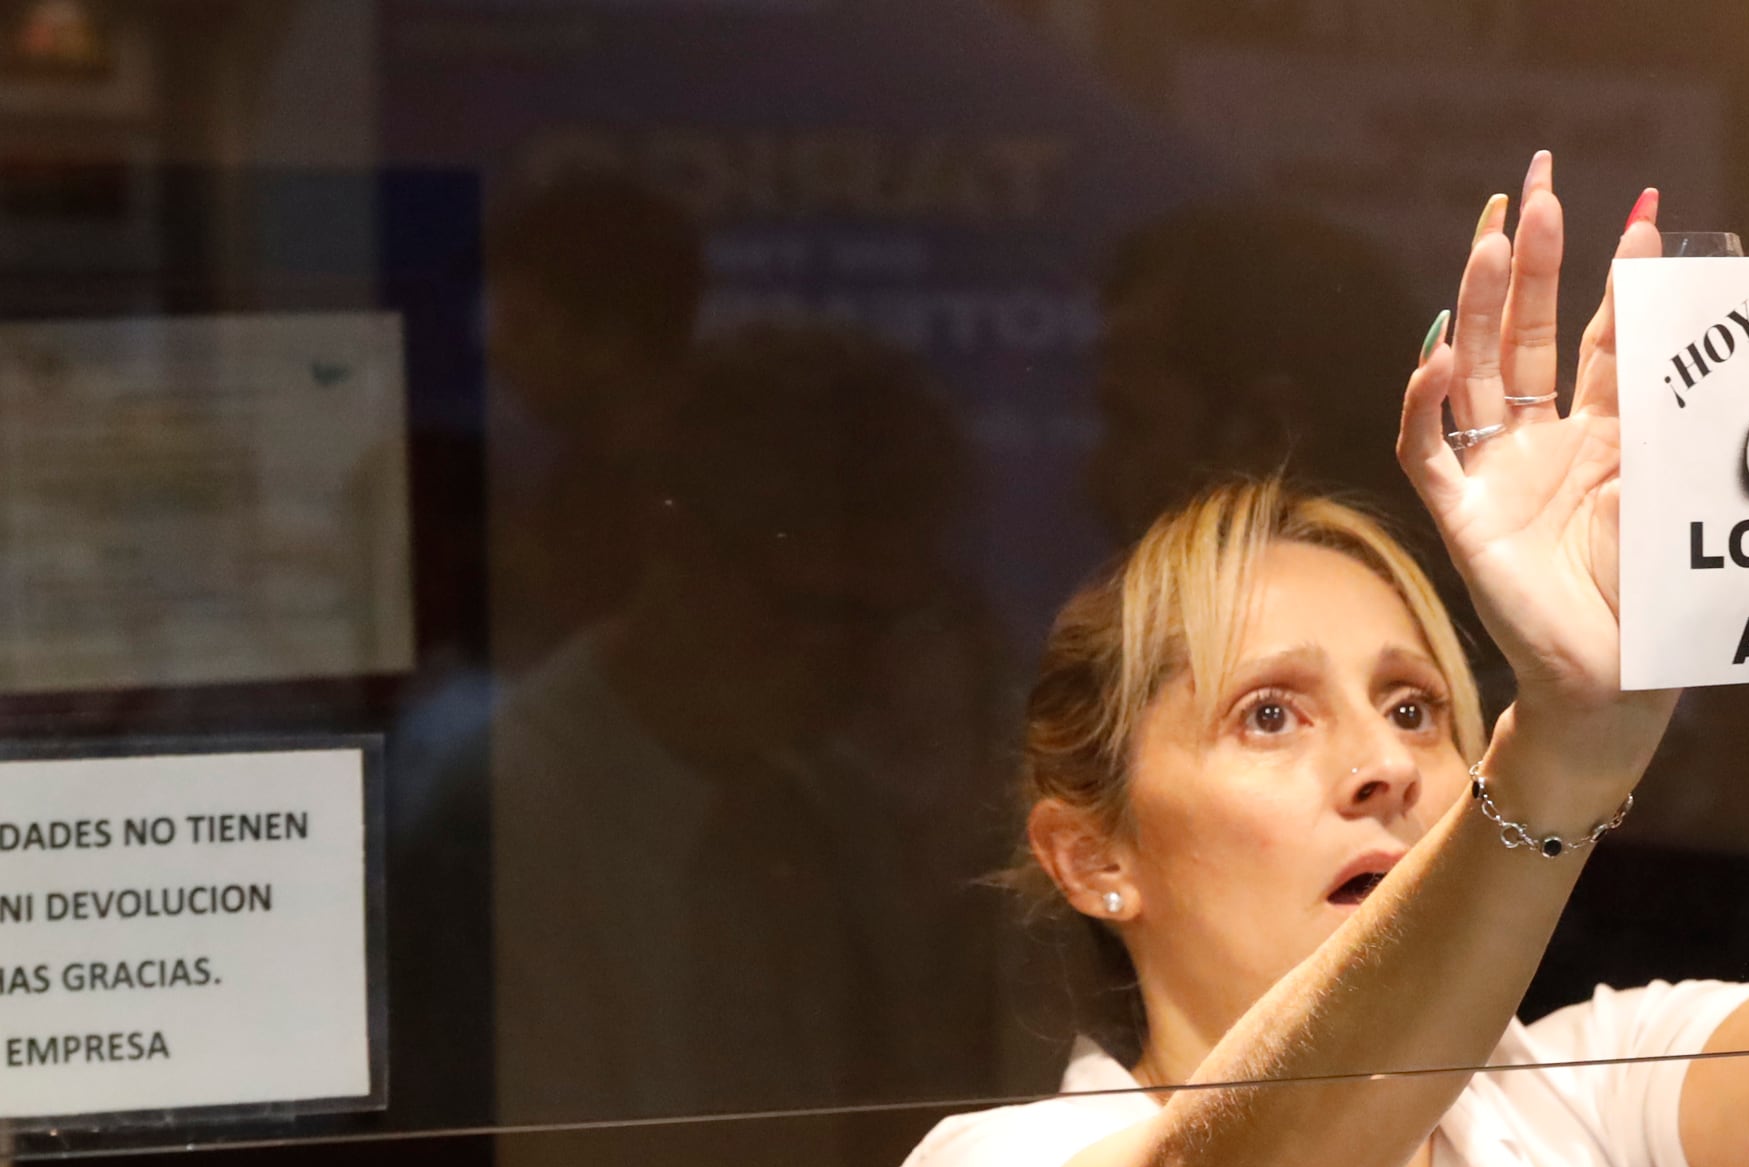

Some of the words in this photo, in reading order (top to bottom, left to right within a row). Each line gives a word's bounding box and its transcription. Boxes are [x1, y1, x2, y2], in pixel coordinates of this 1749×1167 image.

[0, 819, 112, 852] DADES
[123, 817, 176, 847] NO
[186, 812, 309, 844] TIENEN
[0, 893, 33, 924] NI
[46, 883, 273, 922] DEVOLUCION
[0, 964, 51, 995] AS
[62, 956, 222, 992] GRACIAS.
[7, 1031, 171, 1067] EMPRESA
